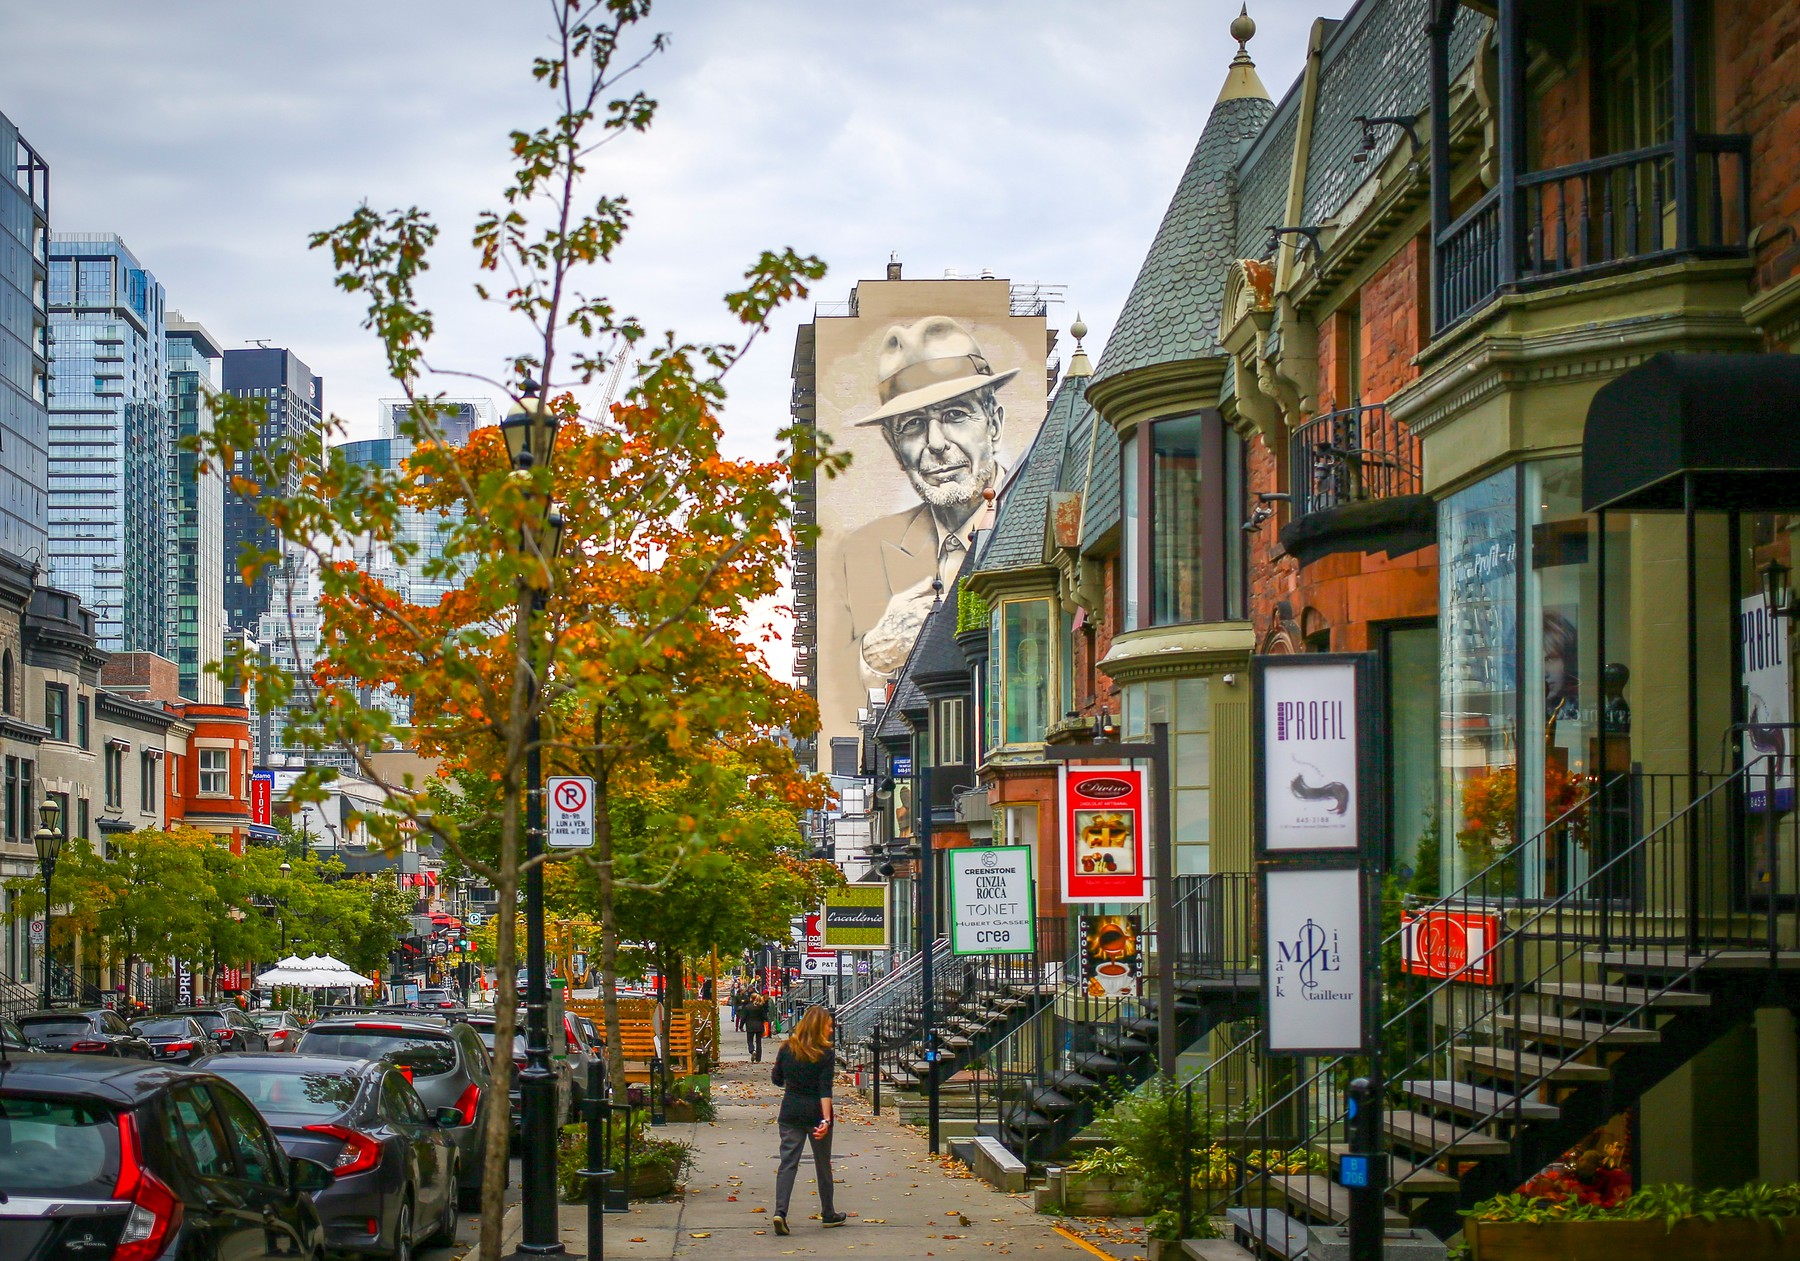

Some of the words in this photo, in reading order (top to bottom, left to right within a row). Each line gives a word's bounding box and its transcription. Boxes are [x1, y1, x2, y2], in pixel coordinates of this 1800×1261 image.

[1285, 700, 1347, 740] PROFIL
[1080, 782, 1130, 792] Divine
[964, 867, 1016, 875] CREENSTONE
[975, 876, 1007, 888] CINZIA
[976, 887, 1007, 900] ROCCA
[966, 902, 1019, 916] TONET
[976, 929, 1010, 943] crea
[1080, 920, 1089, 994] CHOCOLAT
[1135, 935, 1143, 978] CHAUD
[1309, 990, 1354, 1000] tailleur
[1351, 1158, 1359, 1171] B
[1345, 1172, 1364, 1184] 706
